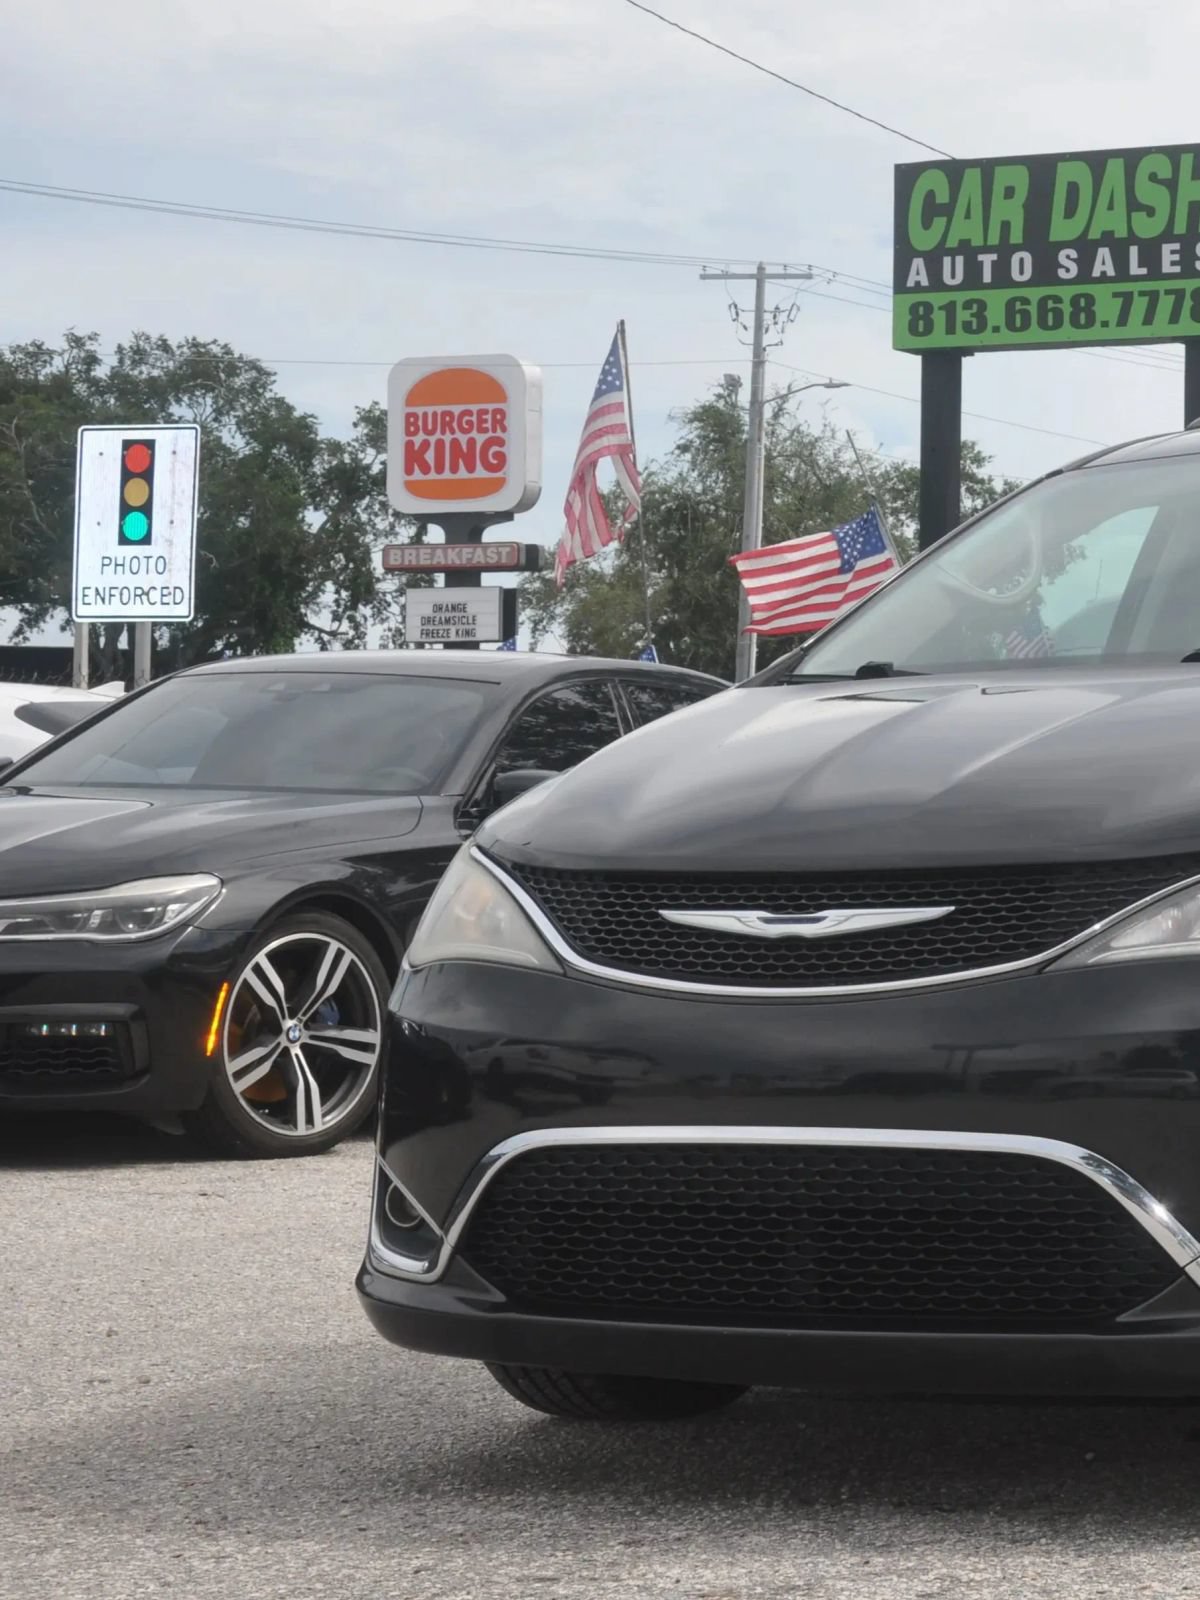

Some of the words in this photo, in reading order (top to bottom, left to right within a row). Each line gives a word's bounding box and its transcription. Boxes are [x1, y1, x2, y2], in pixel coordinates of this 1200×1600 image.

[908, 164, 1030, 252] CAR
[906, 250, 1033, 288] AUTO
[404, 407, 507, 437] BURGER
[404, 435, 507, 477] KING
[100, 555, 167, 575] PHOTO
[389, 546, 511, 566] BREAKFAST
[81, 586, 185, 606] ENFORCED
[432, 602, 468, 613] ORANGE
[420, 615, 477, 626] DREAMSICLE
[420, 628, 452, 639] FREEZE
[455, 628, 476, 638] KING
